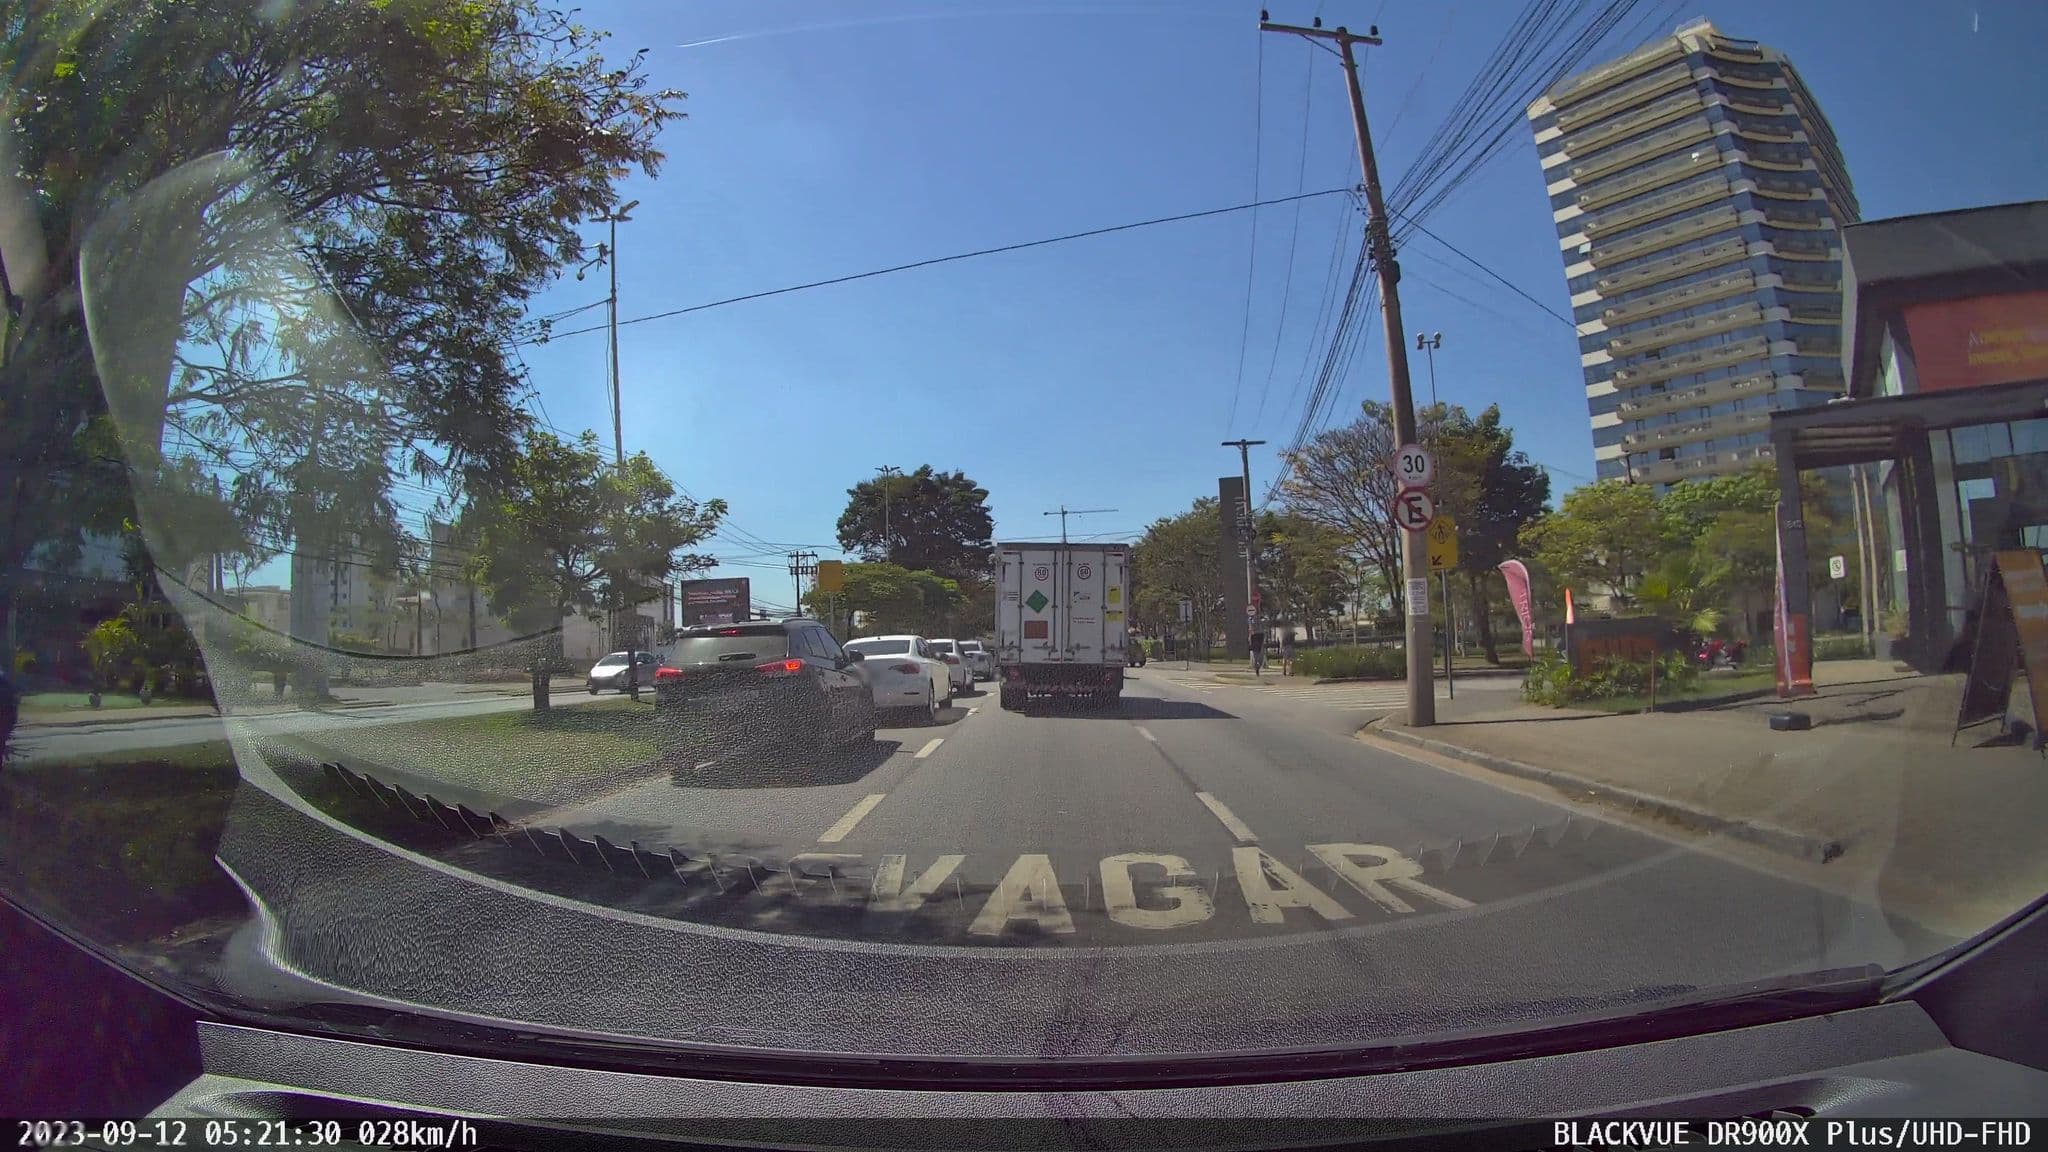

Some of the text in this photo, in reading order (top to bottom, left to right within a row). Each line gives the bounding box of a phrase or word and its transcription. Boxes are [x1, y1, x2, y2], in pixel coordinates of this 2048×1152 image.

[1403, 455, 1425, 473] 30
[1407, 496, 1423, 524] E
[690, 843, 1476, 937] VAGAR
